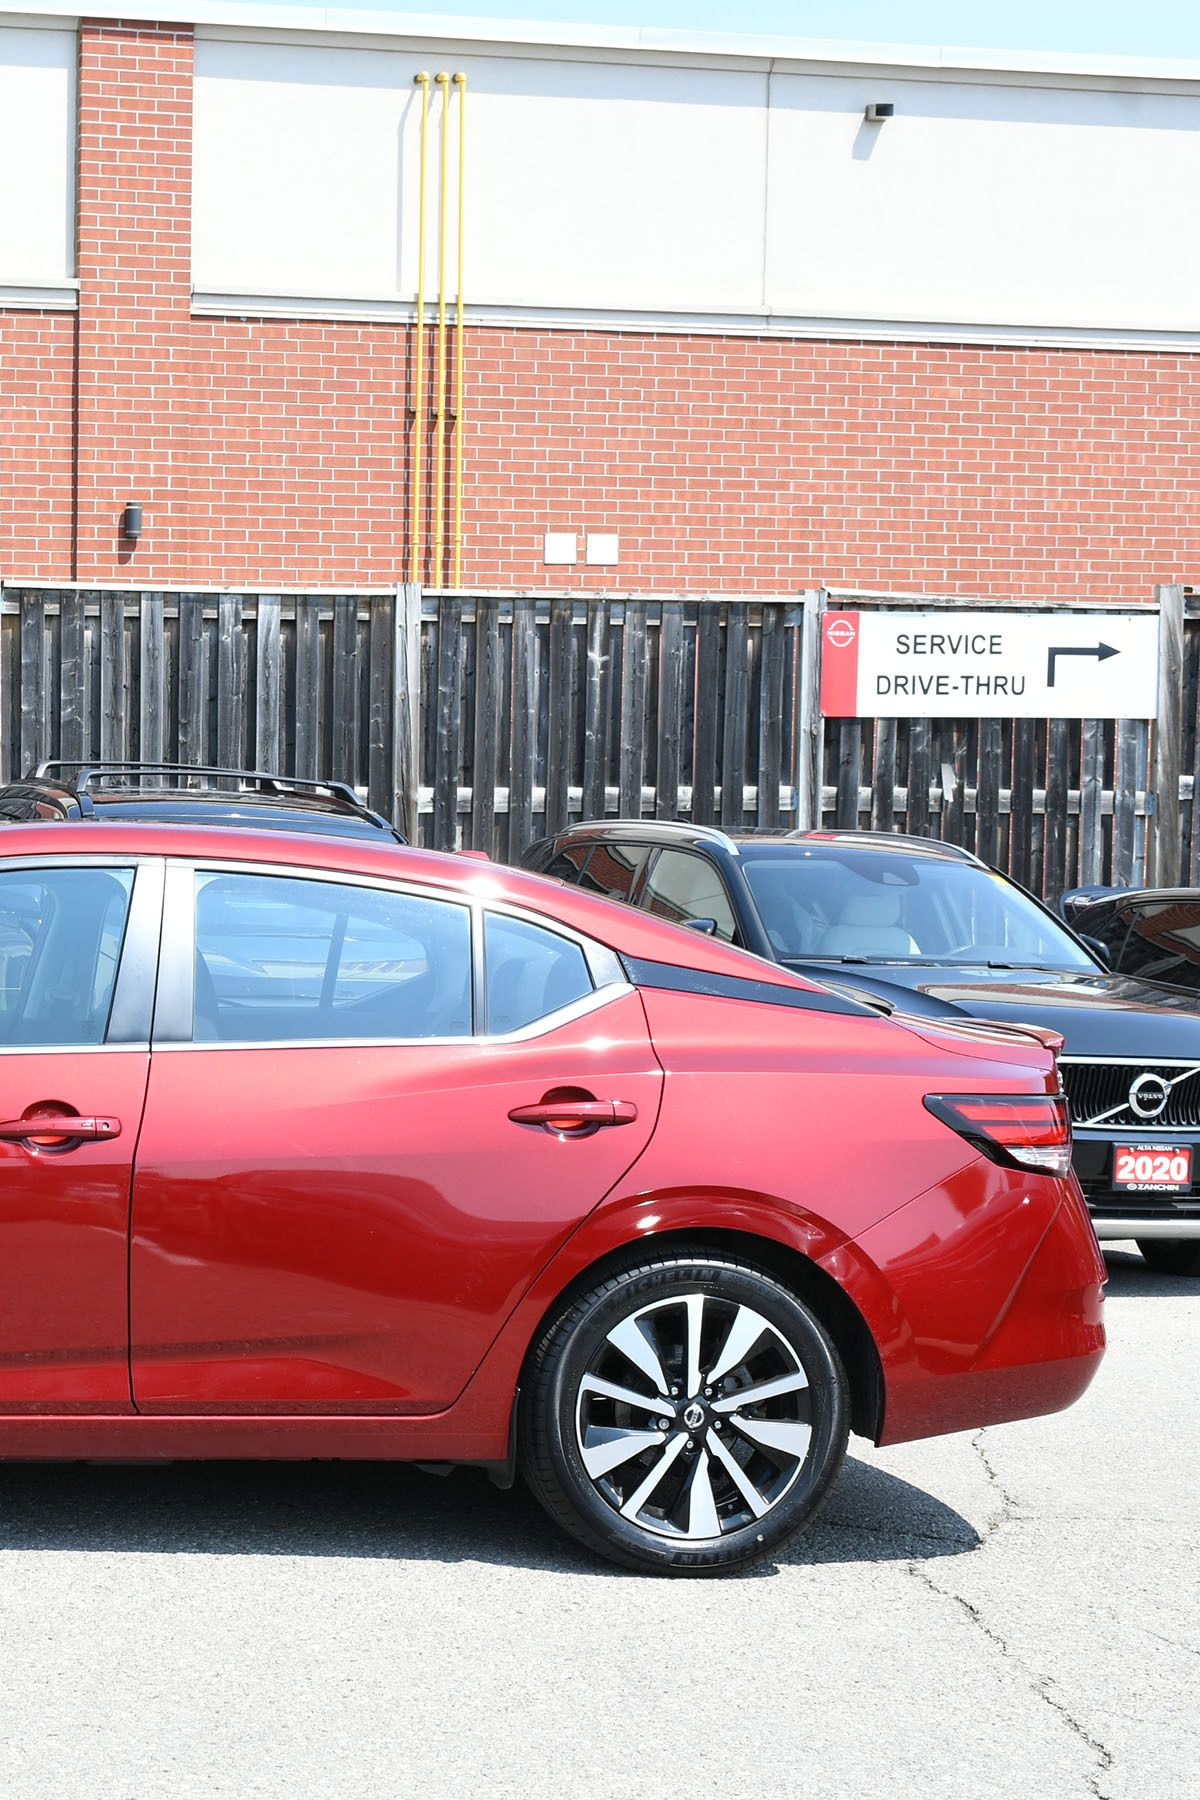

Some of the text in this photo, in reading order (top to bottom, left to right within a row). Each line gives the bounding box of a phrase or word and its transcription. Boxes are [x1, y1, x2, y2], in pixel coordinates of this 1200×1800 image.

[895, 634, 1003, 655] SERVICE
[876, 675, 1026, 696] DRIVE-THRU
[1137, 1092, 1164, 1101] VOLVO
[1116, 1155, 1188, 1181] 2020
[1137, 1183, 1180, 1191] ZANCHIN
